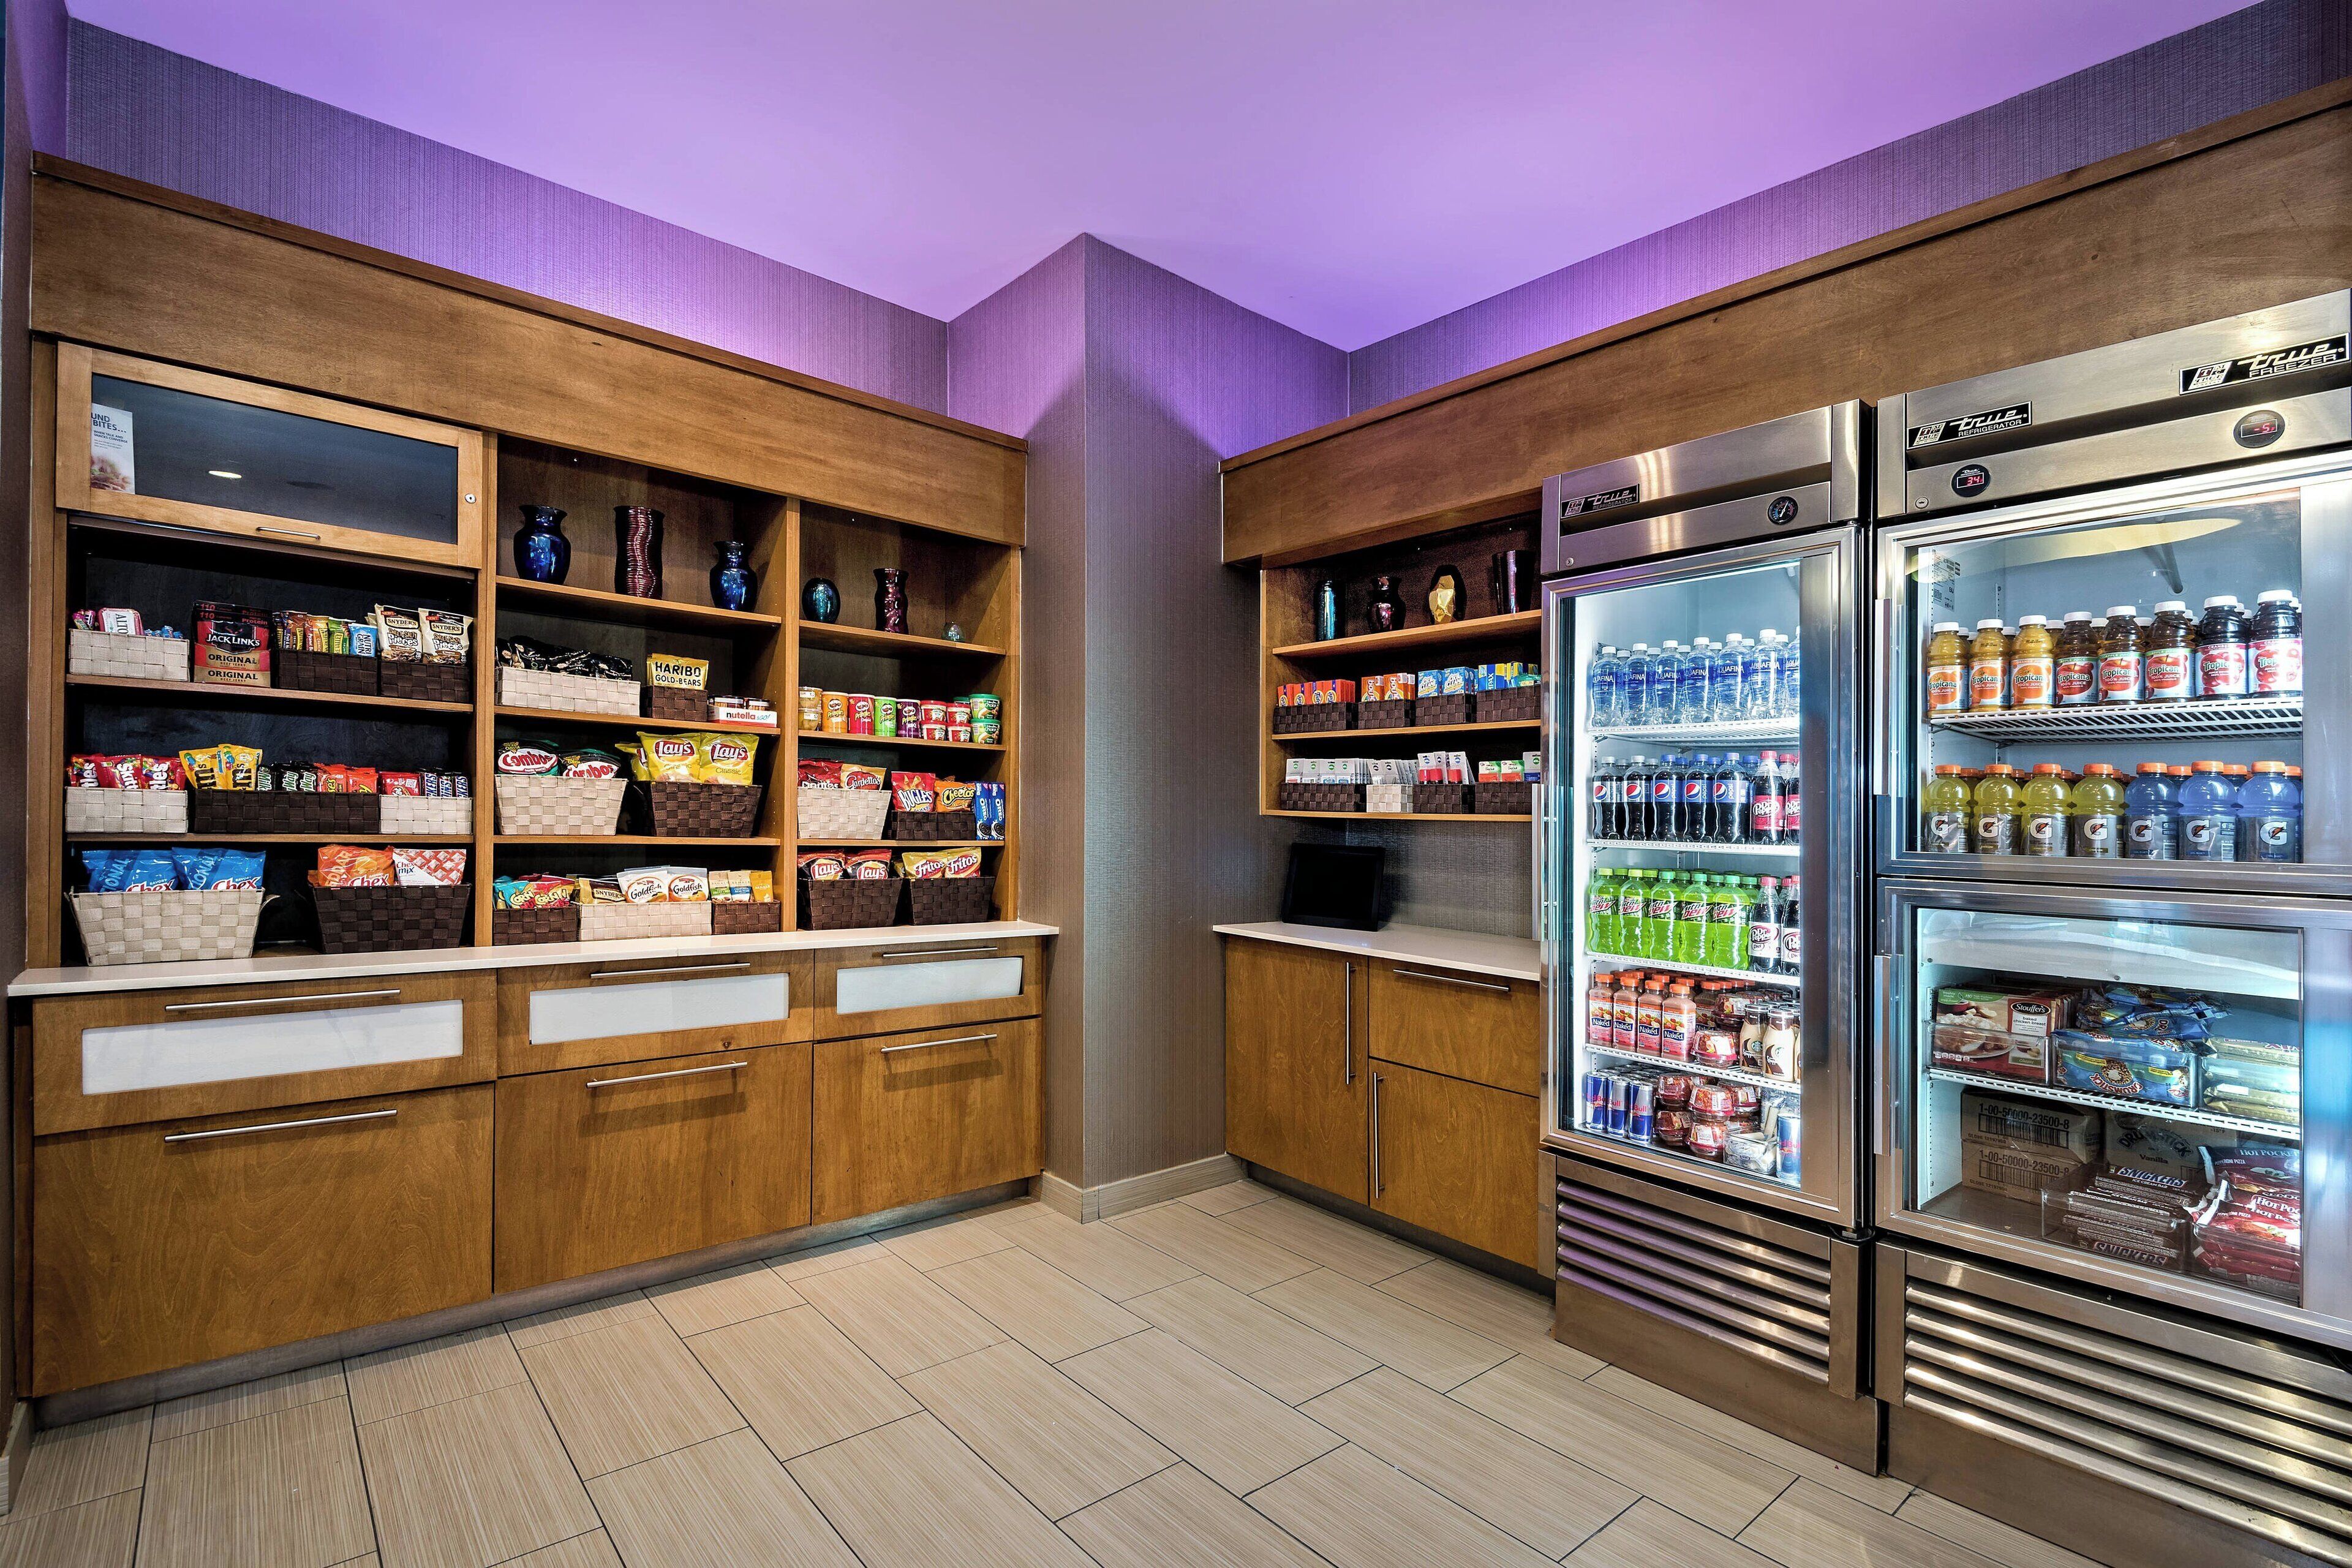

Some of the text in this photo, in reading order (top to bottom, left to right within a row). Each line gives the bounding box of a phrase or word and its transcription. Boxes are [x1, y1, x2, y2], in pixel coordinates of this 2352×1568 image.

[2248, 353, 2336, 378] FREEZER
[1958, 419, 2022, 437] REFRIGERATOR
[1593, 497, 1632, 510] REFRIGERATOR
[206, 634, 232, 644] JACK
[356, 633, 365, 654] GRAIN
[363, 634, 372, 655] NUTRI
[208, 654, 257, 665] ORIGINAL
[208, 670, 258, 680] ORIGINAL
[655, 662, 702, 677] HARIBO
[2148, 665, 2179, 676] Tropican
[655, 674, 702, 687] GOLD-BEARS
[1929, 680, 1957, 690] Tropicana
[2015, 674, 2045, 684] Tropican
[2057, 673, 2090, 684] Tropicana
[726, 711, 756, 720] nutella
[827, 709, 845, 718] Pringles
[854, 710, 871, 720] Pringles
[658, 741, 692, 756] Lay's
[713, 744, 748, 760] Lay's
[502, 752, 554, 766] Combos
[844, 775, 881, 789] Gardetto's
[897, 789, 933, 810] BUGLES
[943, 786, 975, 806] Cheetos
[1931, 815, 1950, 835] G
[1978, 816, 1999, 838] G
[2029, 818, 2053, 840] G
[2084, 818, 2108, 840] G
[2130, 819, 2154, 843] G
[2185, 820, 2211, 843] G
[2259, 821, 2288, 845] G
[815, 864, 841, 879] Lay's
[913, 859, 945, 878] Fritos
[947, 855, 978, 874] Fritos
[349, 874, 390, 886] Chex
[595, 889, 624, 899] SNYDER'S
[673, 883, 703, 894] Goldfish
[2015, 1003, 2046, 1013] Stouffer's
[1664, 1031, 1683, 1040] Naked
[2089, 1072, 2143, 1094] DRUMSTICK
[1979, 1149, 2070, 1175] 1-00-50000-23500-8
[2139, 1153, 2168, 1164] Vanilla
[2118, 1167, 2186, 1188] SNICKERS
[2256, 1197, 2279, 1210] HOT
[2095, 1242, 2166, 1266] SNICKERS
